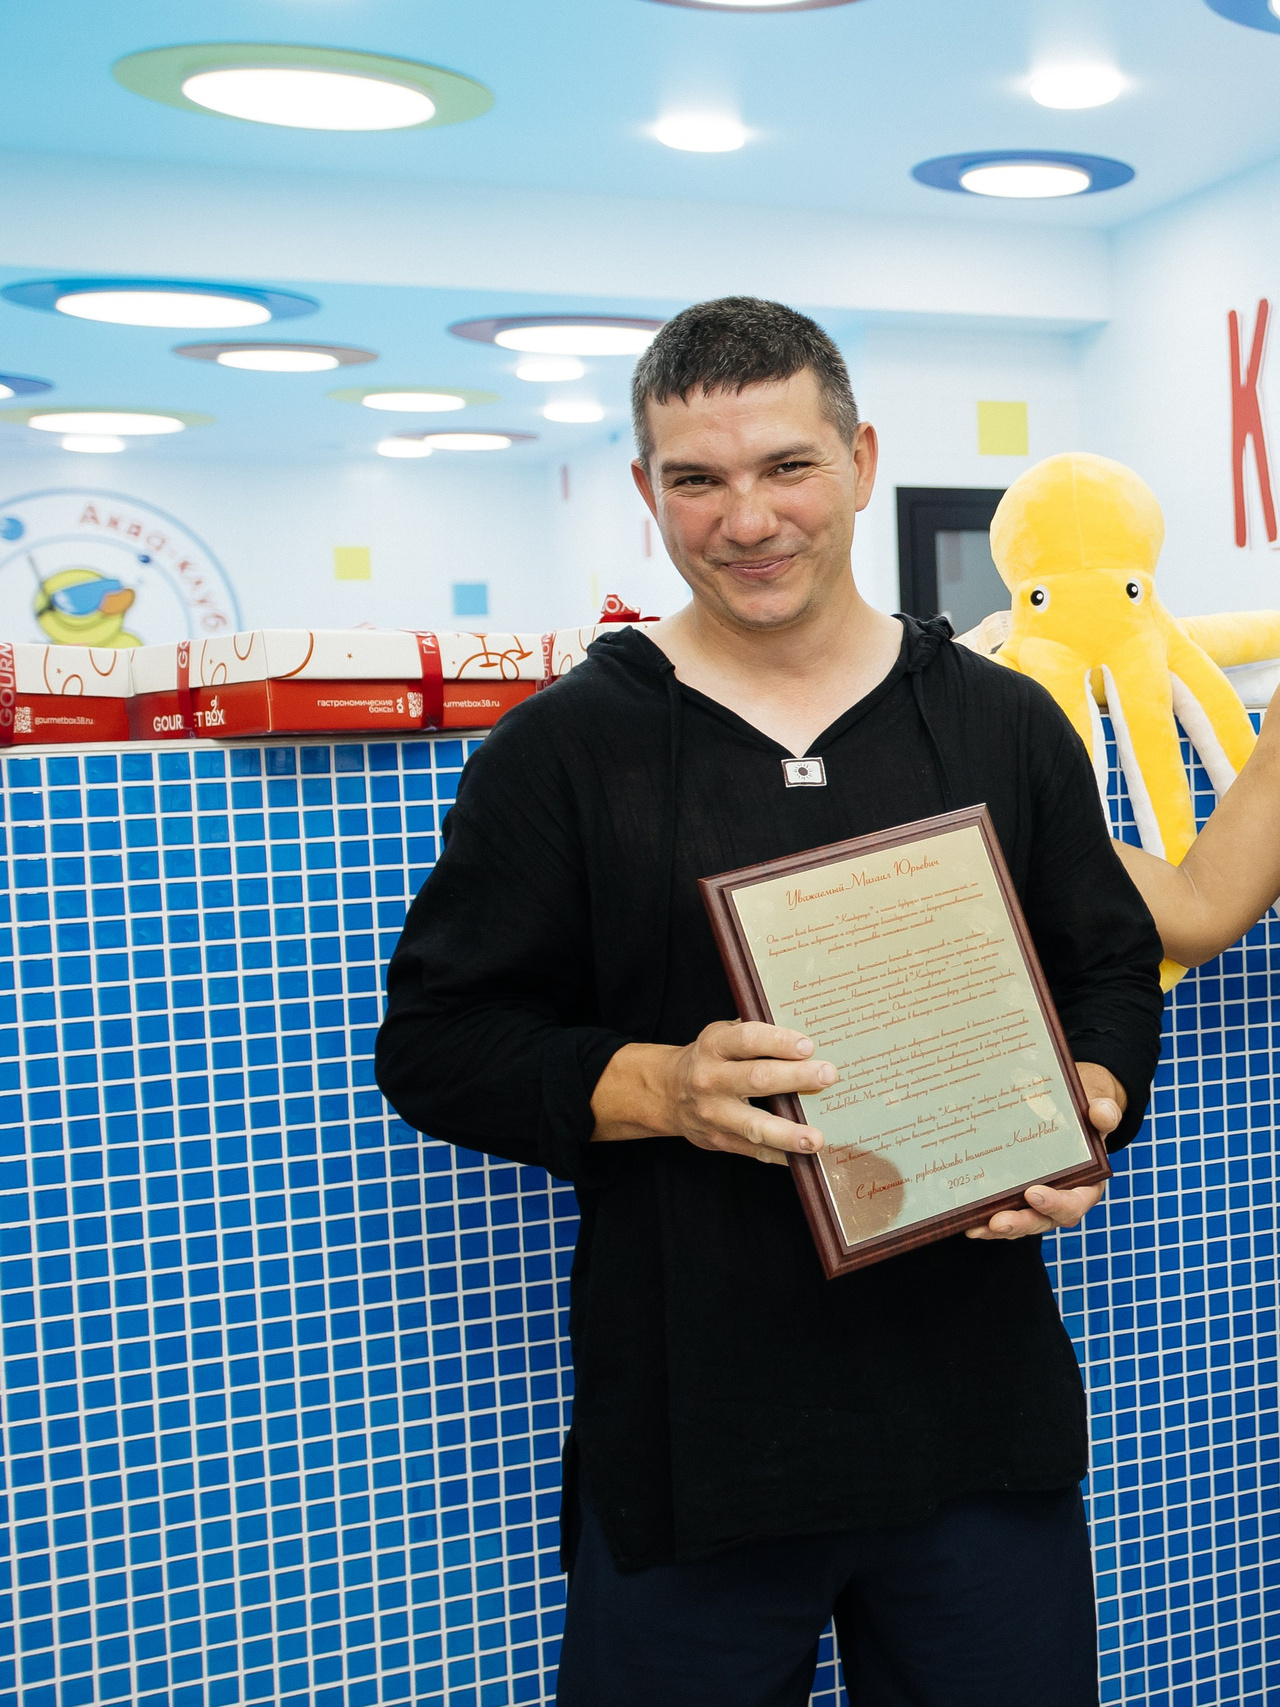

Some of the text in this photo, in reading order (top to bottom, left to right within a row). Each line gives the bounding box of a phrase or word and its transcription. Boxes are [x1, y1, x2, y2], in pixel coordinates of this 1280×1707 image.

[317, 699, 393, 708] гастрономические
[369, 705, 394, 714] боксы
[444, 699, 500, 708] urmetbox38.ru
[34, 716, 94, 726] gourmetbox38.ru
[153, 702, 226, 732] GOURT BOX
[785, 854, 939, 910] Уважаемый Михаил Юрьевич
[855, 1183, 865, 1199] С
[867, 1177, 912, 1199] уважением,
[915, 1152, 963, 1183] руководство
[964, 1144, 1003, 1161] компании
[947, 1165, 985, 1189] 2025 год
